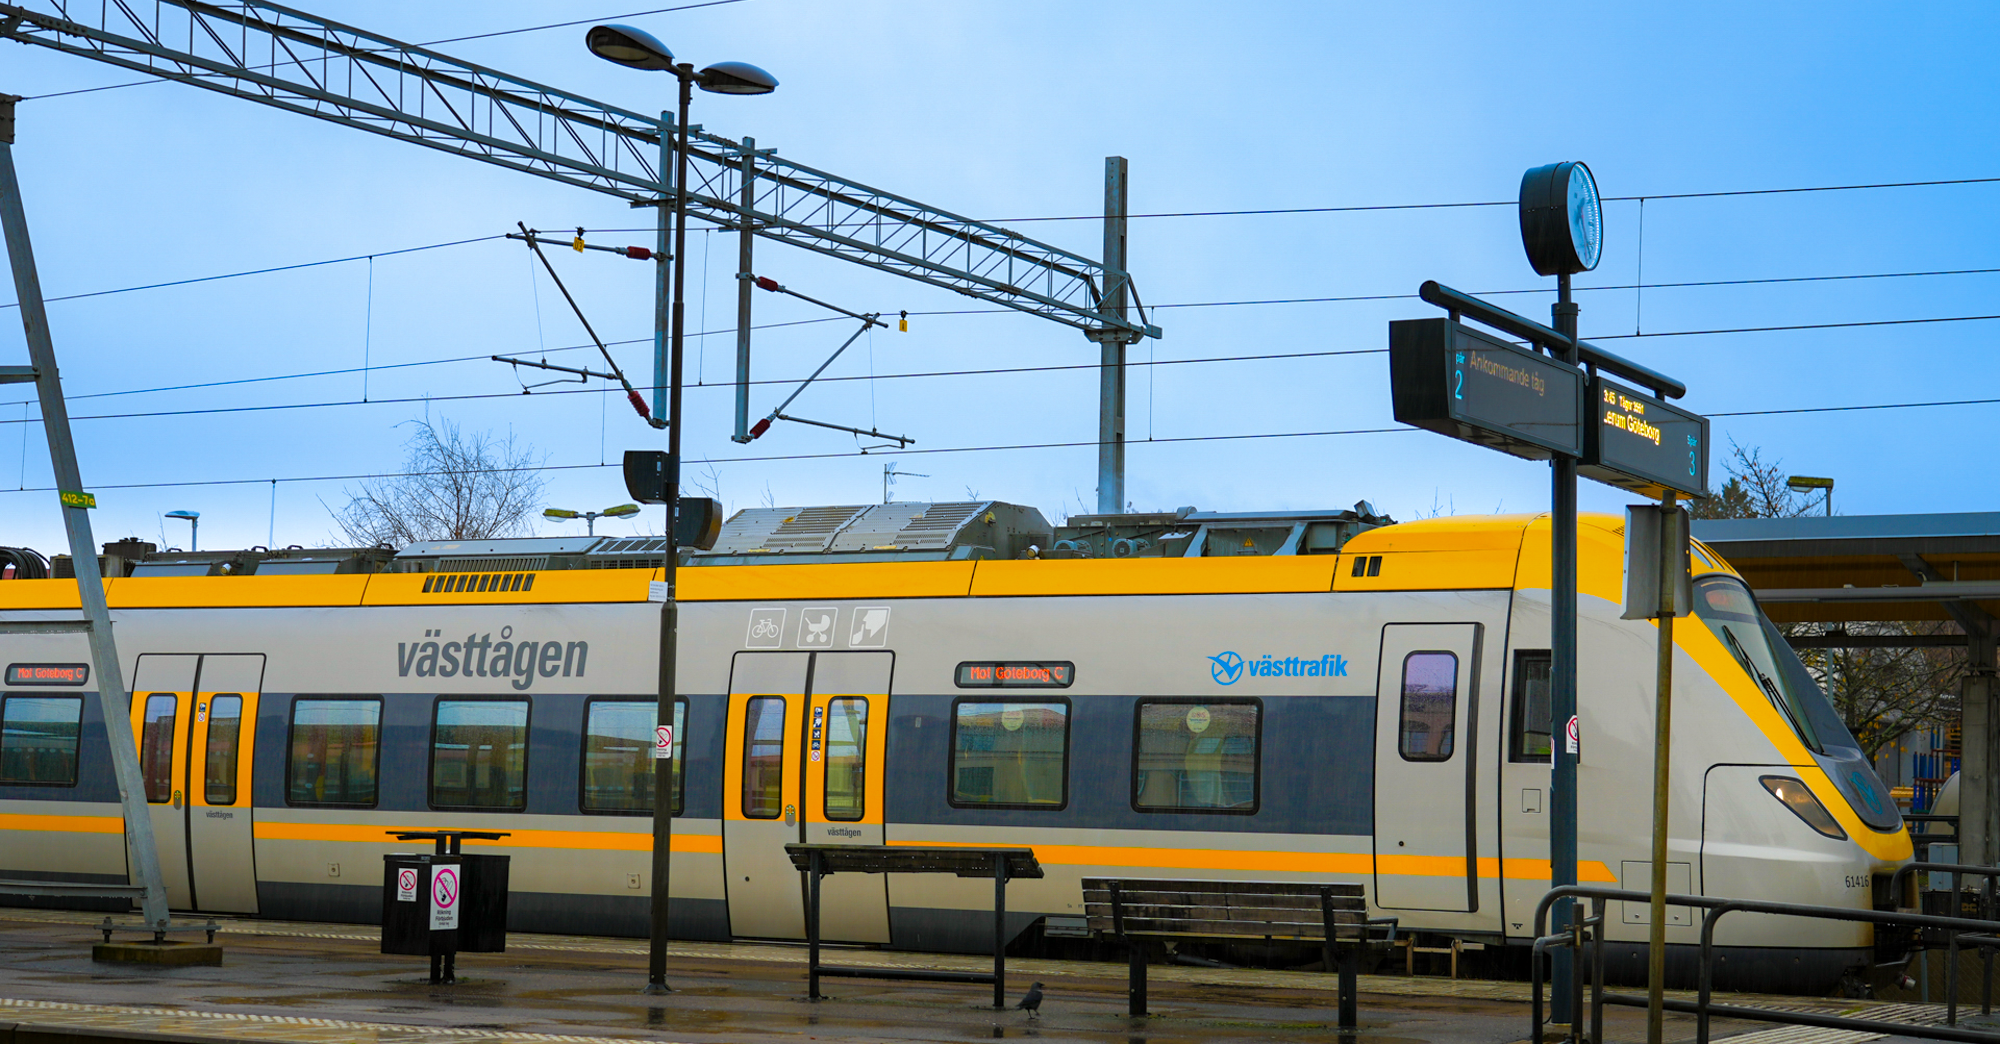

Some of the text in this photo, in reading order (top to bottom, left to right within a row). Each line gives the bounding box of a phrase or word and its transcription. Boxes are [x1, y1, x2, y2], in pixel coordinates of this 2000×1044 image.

[1470, 350, 1530, 387] Ankommande
[1455, 369, 1464, 400] 2
[1627, 414, 1661, 446] Göteborg
[1688, 450, 1696, 476] 3
[62, 493, 96, 506] 412-7a
[398, 625, 589, 691] västtågen
[1248, 654, 1348, 677] västtrafik
[18, 667, 84, 682] Mot Göteborg C
[970, 666, 1064, 682] Mot Göteborg C
[205, 810, 233, 820] västtågen
[827, 827, 862, 838] västtågen
[1845, 875, 1870, 888] 61416
